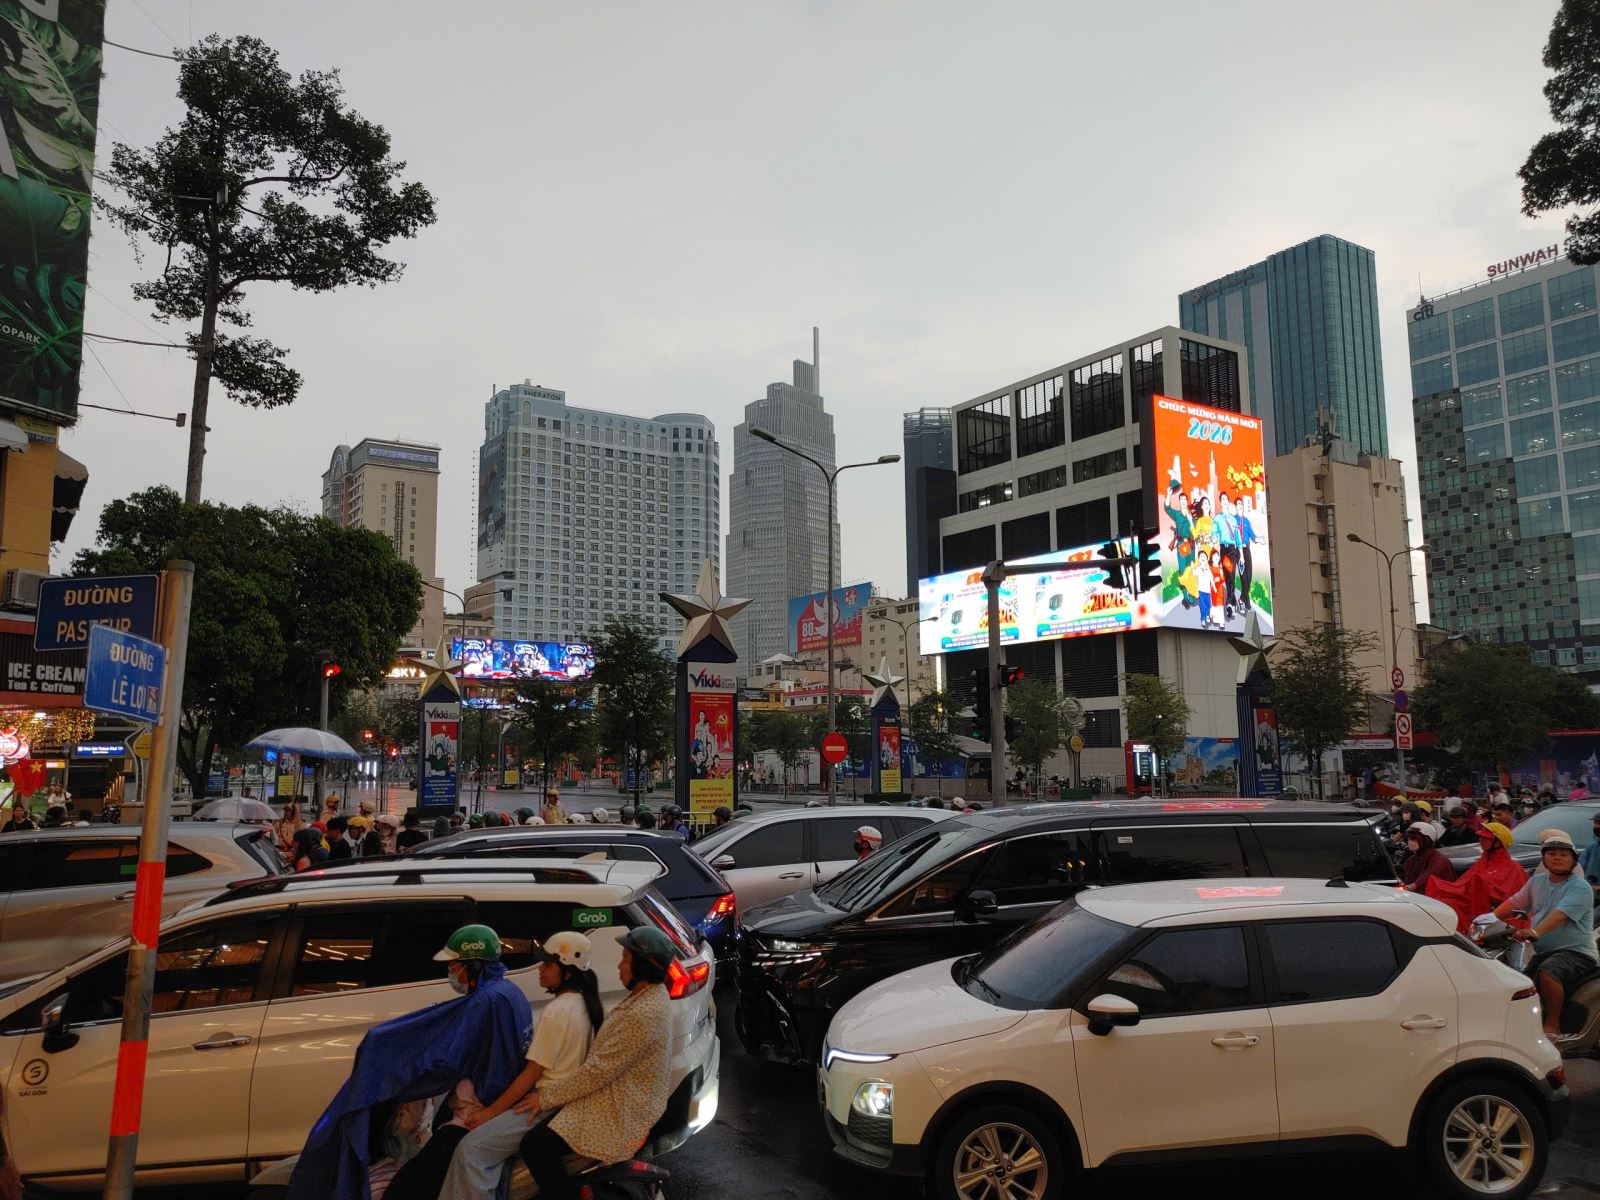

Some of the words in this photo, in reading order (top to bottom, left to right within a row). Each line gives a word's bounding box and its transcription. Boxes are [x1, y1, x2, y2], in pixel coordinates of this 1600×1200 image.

[1487, 243, 1559, 278] SUNWAH
[1413, 303, 1434, 321] citi
[0, 323, 41, 345] OPARK
[524, 389, 561, 401] SHERATON
[1188, 417, 1233, 446] 2026
[64, 585, 133, 606] ĐƯỜNG
[1090, 592, 1124, 612] 2026
[802, 621, 814, 638] 80
[110, 642, 154, 672] ĐƯỜNG
[8, 662, 31, 679] ICE
[36, 664, 86, 682] CREAM
[690, 668, 720, 688] Vikki
[8, 680, 27, 690] Tea
[30, 681, 38, 690] &
[42, 681, 75, 693] Coffee
[112, 675, 128, 706] LÊ
[427, 707, 449, 719] Vikki
[578, 911, 607, 924] Grab
[461, 941, 486, 951] Grab
